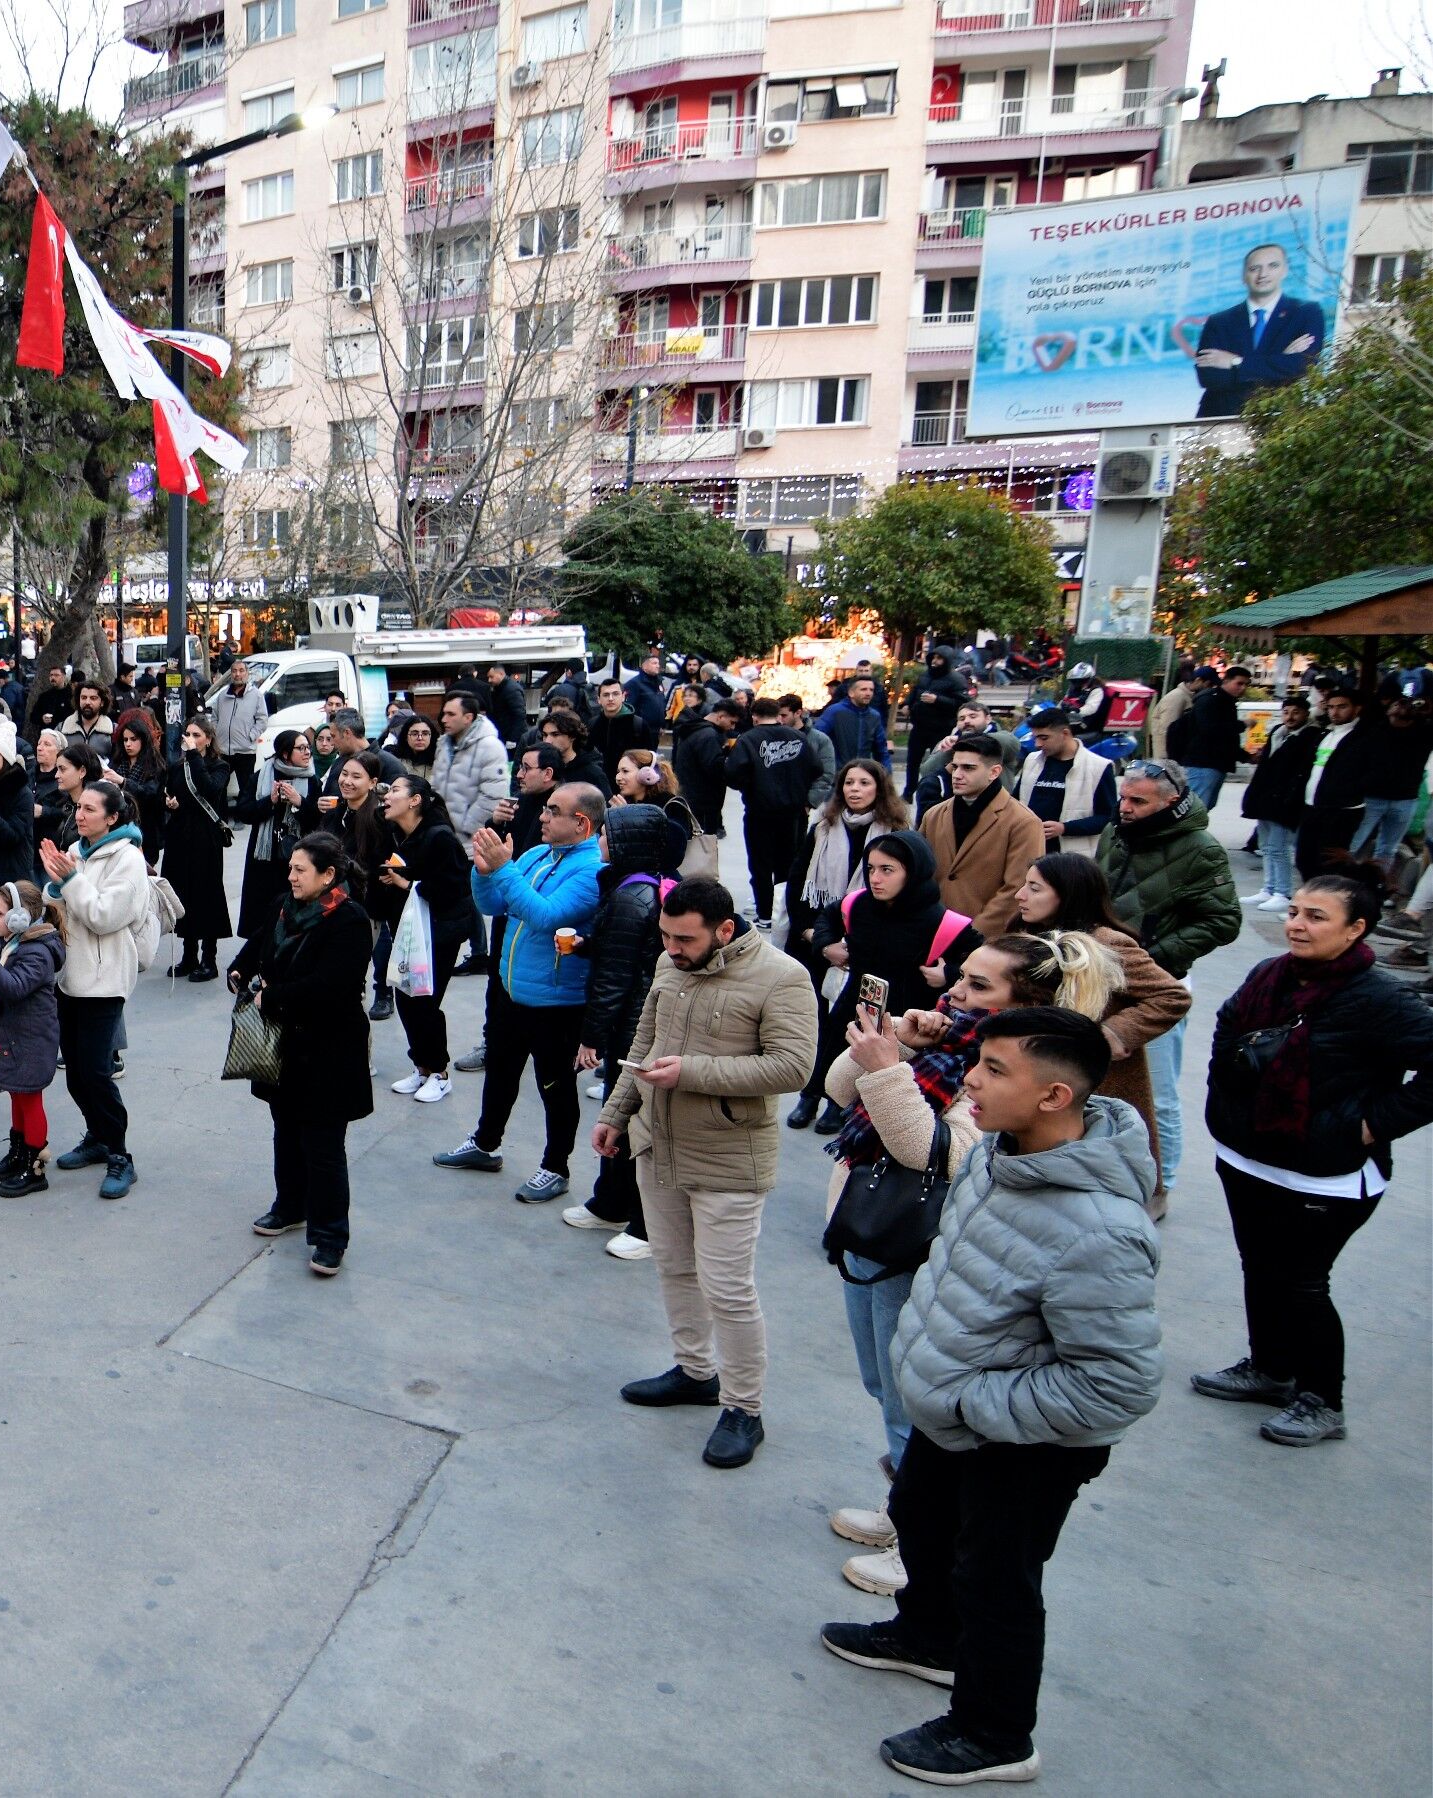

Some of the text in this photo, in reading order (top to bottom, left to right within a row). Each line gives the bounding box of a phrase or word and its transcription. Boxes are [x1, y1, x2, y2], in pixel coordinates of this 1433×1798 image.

[1030, 193, 1303, 242] TEŞEKKÜRLER BORNOVA
[1030, 274, 1053, 286] Yeni
[1056, 273, 1072, 283] bir
[1075, 267, 1122, 284] yönetim
[1027, 285, 1070, 300] GÜÇLÜ
[1072, 280, 1132, 295] BORNOVA
